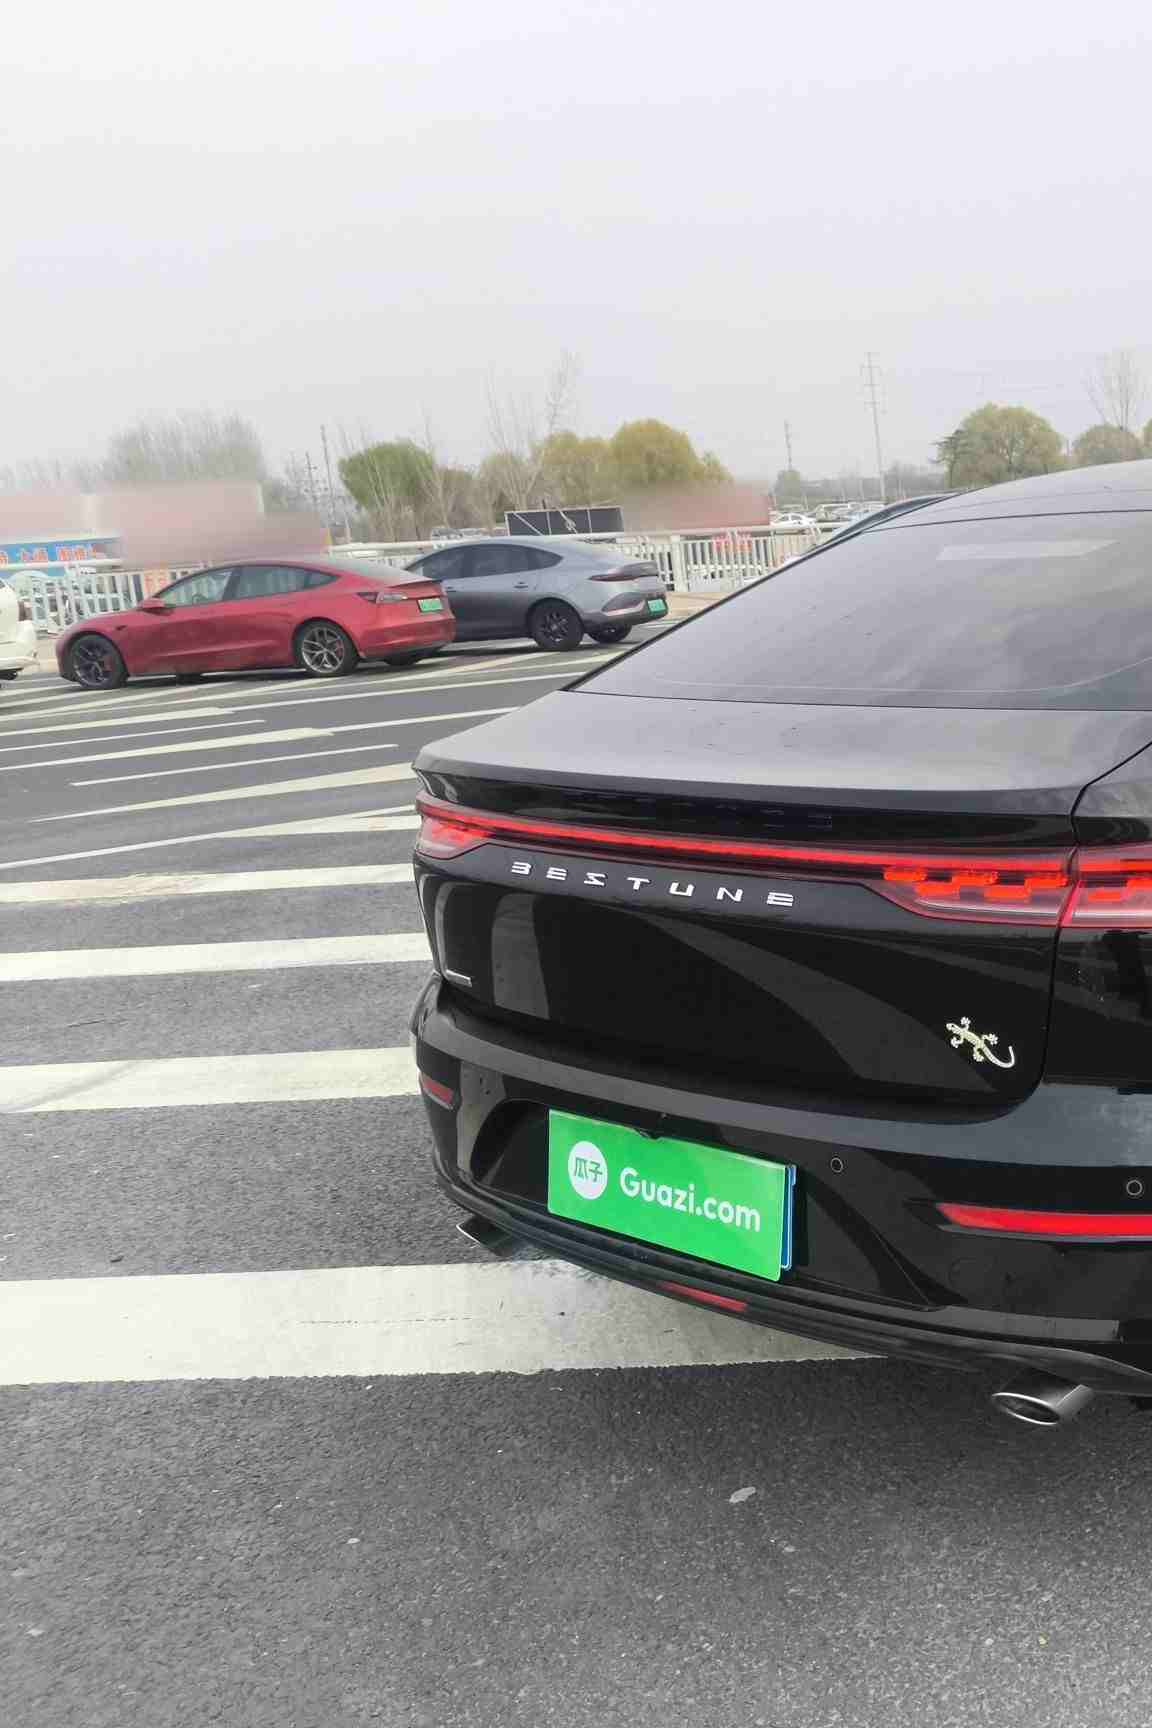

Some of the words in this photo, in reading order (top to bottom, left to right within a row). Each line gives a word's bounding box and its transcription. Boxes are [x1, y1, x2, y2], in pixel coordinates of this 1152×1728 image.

[511, 861, 794, 907] BESTUNE
[572, 1156, 603, 1183] 瓜子
[619, 1167, 761, 1232] Guazi.com
